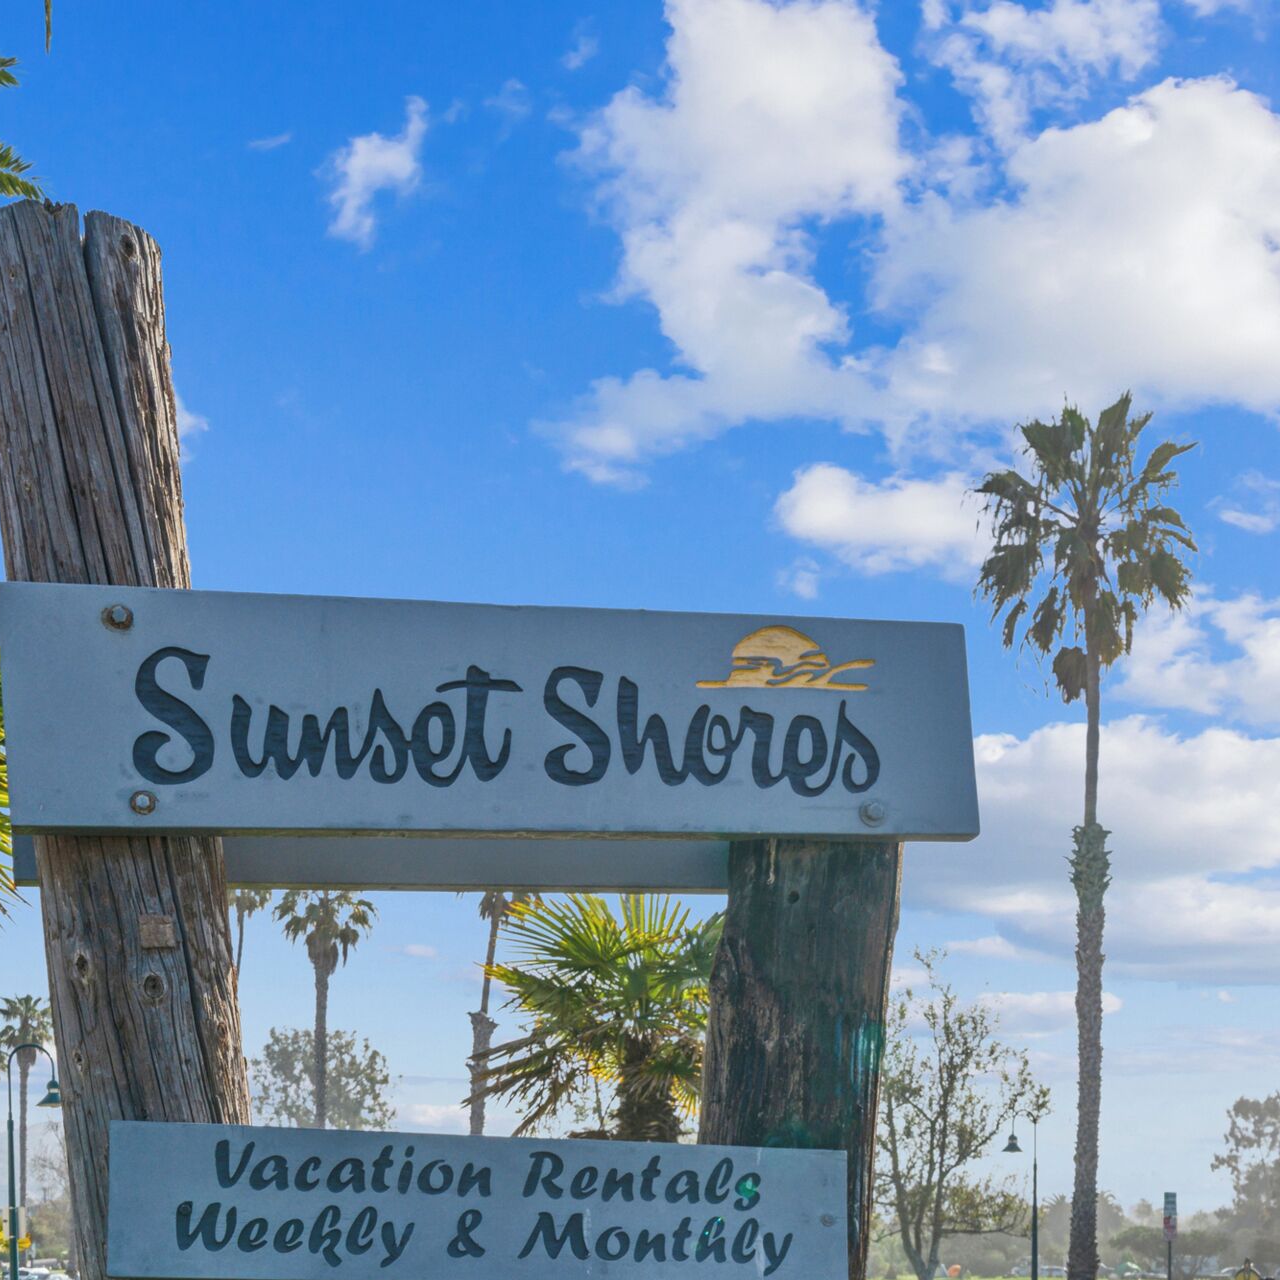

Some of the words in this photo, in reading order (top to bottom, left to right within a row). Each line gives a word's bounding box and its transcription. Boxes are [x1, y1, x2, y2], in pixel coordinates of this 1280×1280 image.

[131, 645, 524, 788] Sunset
[542, 665, 881, 798] Shores
[213, 1138, 494, 1199] Vacation
[521, 1149, 763, 1213] Rentals
[175, 1199, 417, 1270] Weekly
[445, 1207, 488, 1260] &
[516, 1210, 795, 1278] Monthly
